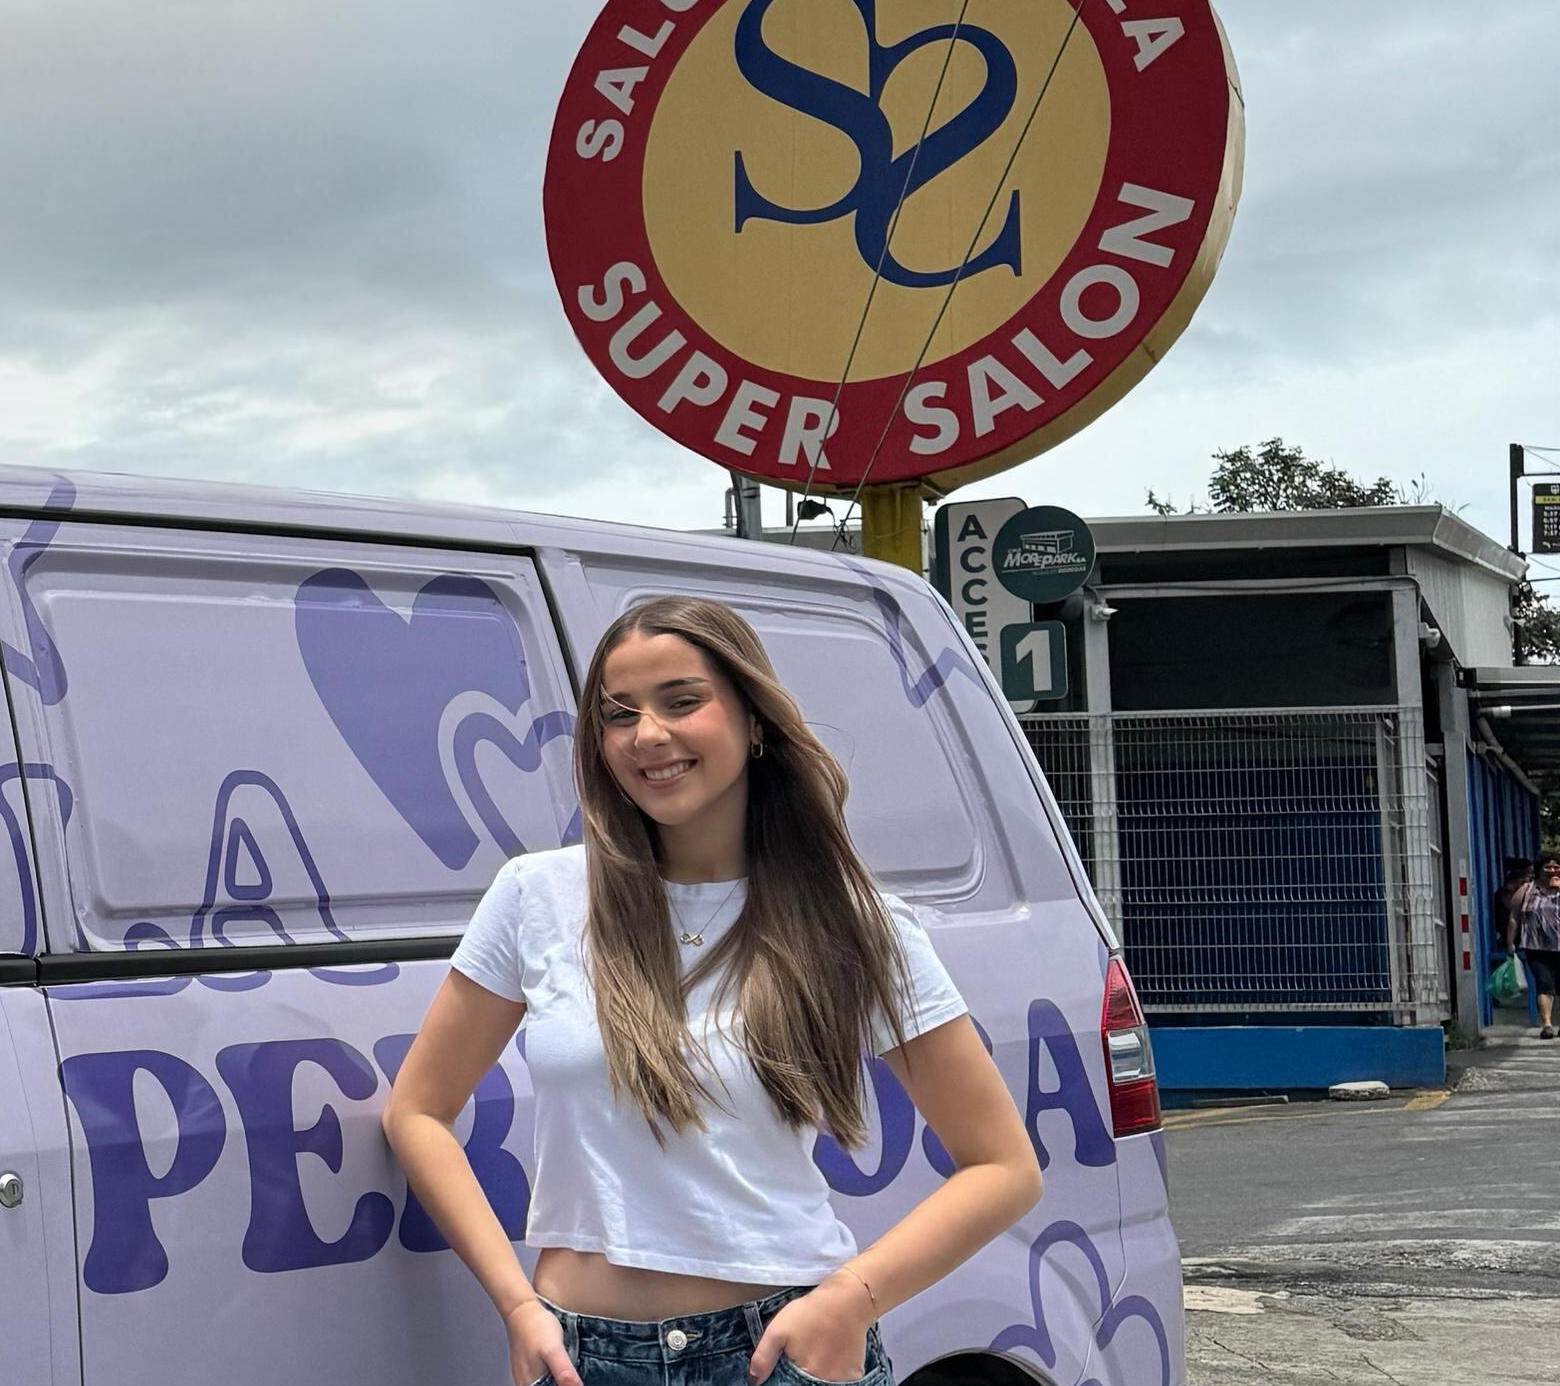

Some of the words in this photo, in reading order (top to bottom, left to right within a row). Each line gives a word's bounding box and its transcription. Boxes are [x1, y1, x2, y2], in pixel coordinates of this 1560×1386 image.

[578, 261, 840, 470] SUPER
[903, 181, 1196, 455] SALON
[1015, 629, 1053, 692] 1
